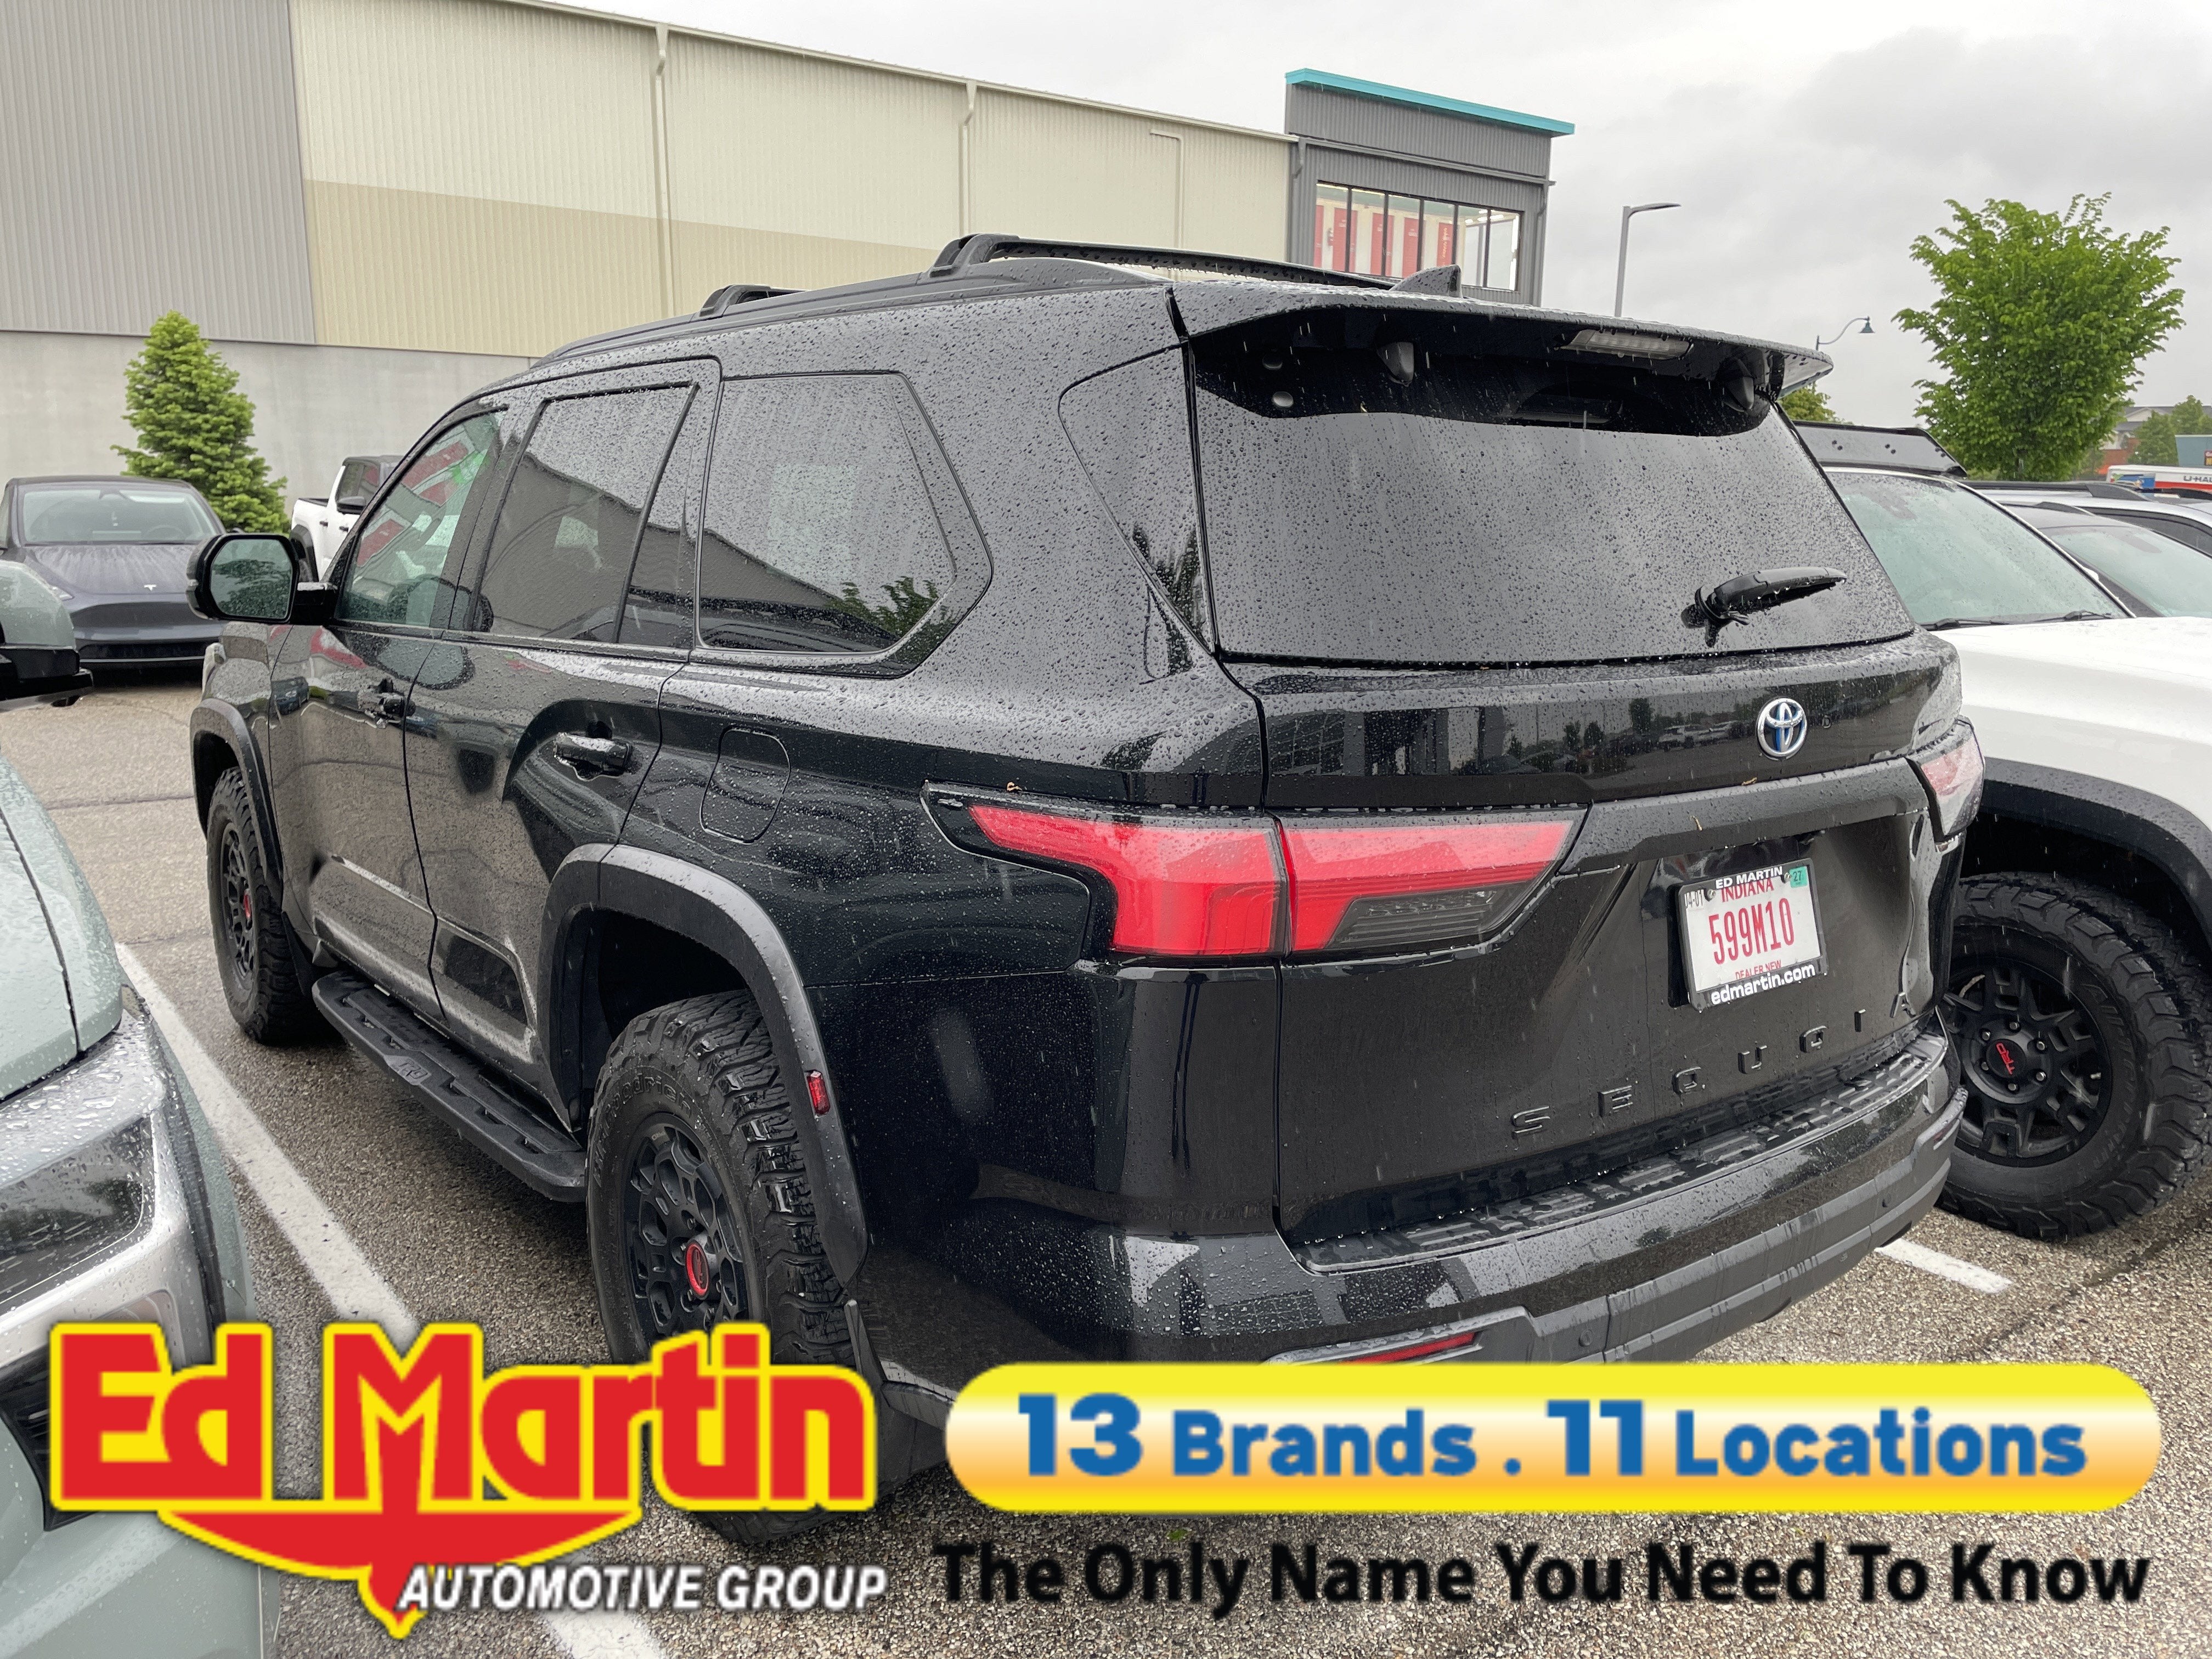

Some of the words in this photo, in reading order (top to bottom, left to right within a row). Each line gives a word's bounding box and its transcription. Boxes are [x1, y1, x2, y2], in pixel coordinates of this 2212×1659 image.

[1716, 878, 1733, 889] ED
[1736, 866, 1782, 884] MARTIN
[1721, 878, 1774, 902] INDIANA
[1708, 898, 1795, 965] 599M10
[1711, 964, 1815, 1005] edmartin.com
[1735, 966, 1763, 980] DEALER
[1765, 960, 1782, 972] NEW
[1511, 991, 1916, 1140] SEQUOIA
[1996, 1042, 2016, 1075] TRD
